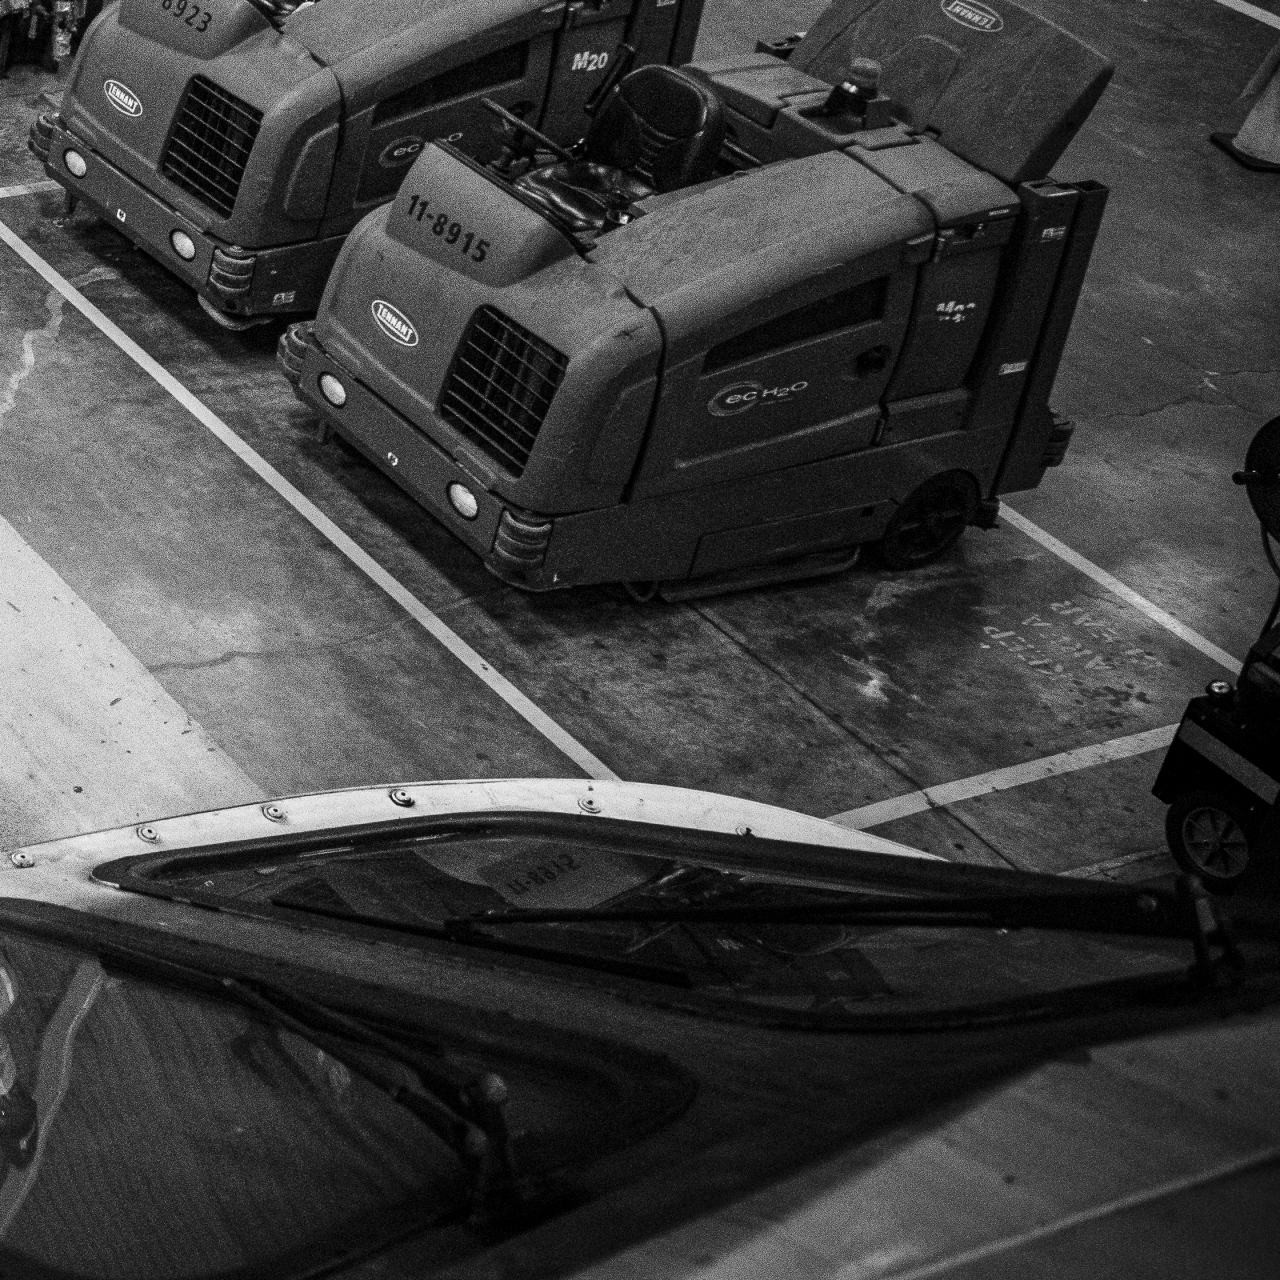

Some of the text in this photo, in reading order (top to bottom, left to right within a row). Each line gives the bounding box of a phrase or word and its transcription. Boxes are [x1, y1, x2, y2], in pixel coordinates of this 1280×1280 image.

[571, 50, 610, 72] M20
[106, 81, 140, 115] TENNANT
[407, 194, 491, 264] 11-8915
[374, 301, 415, 344] TENNANT
